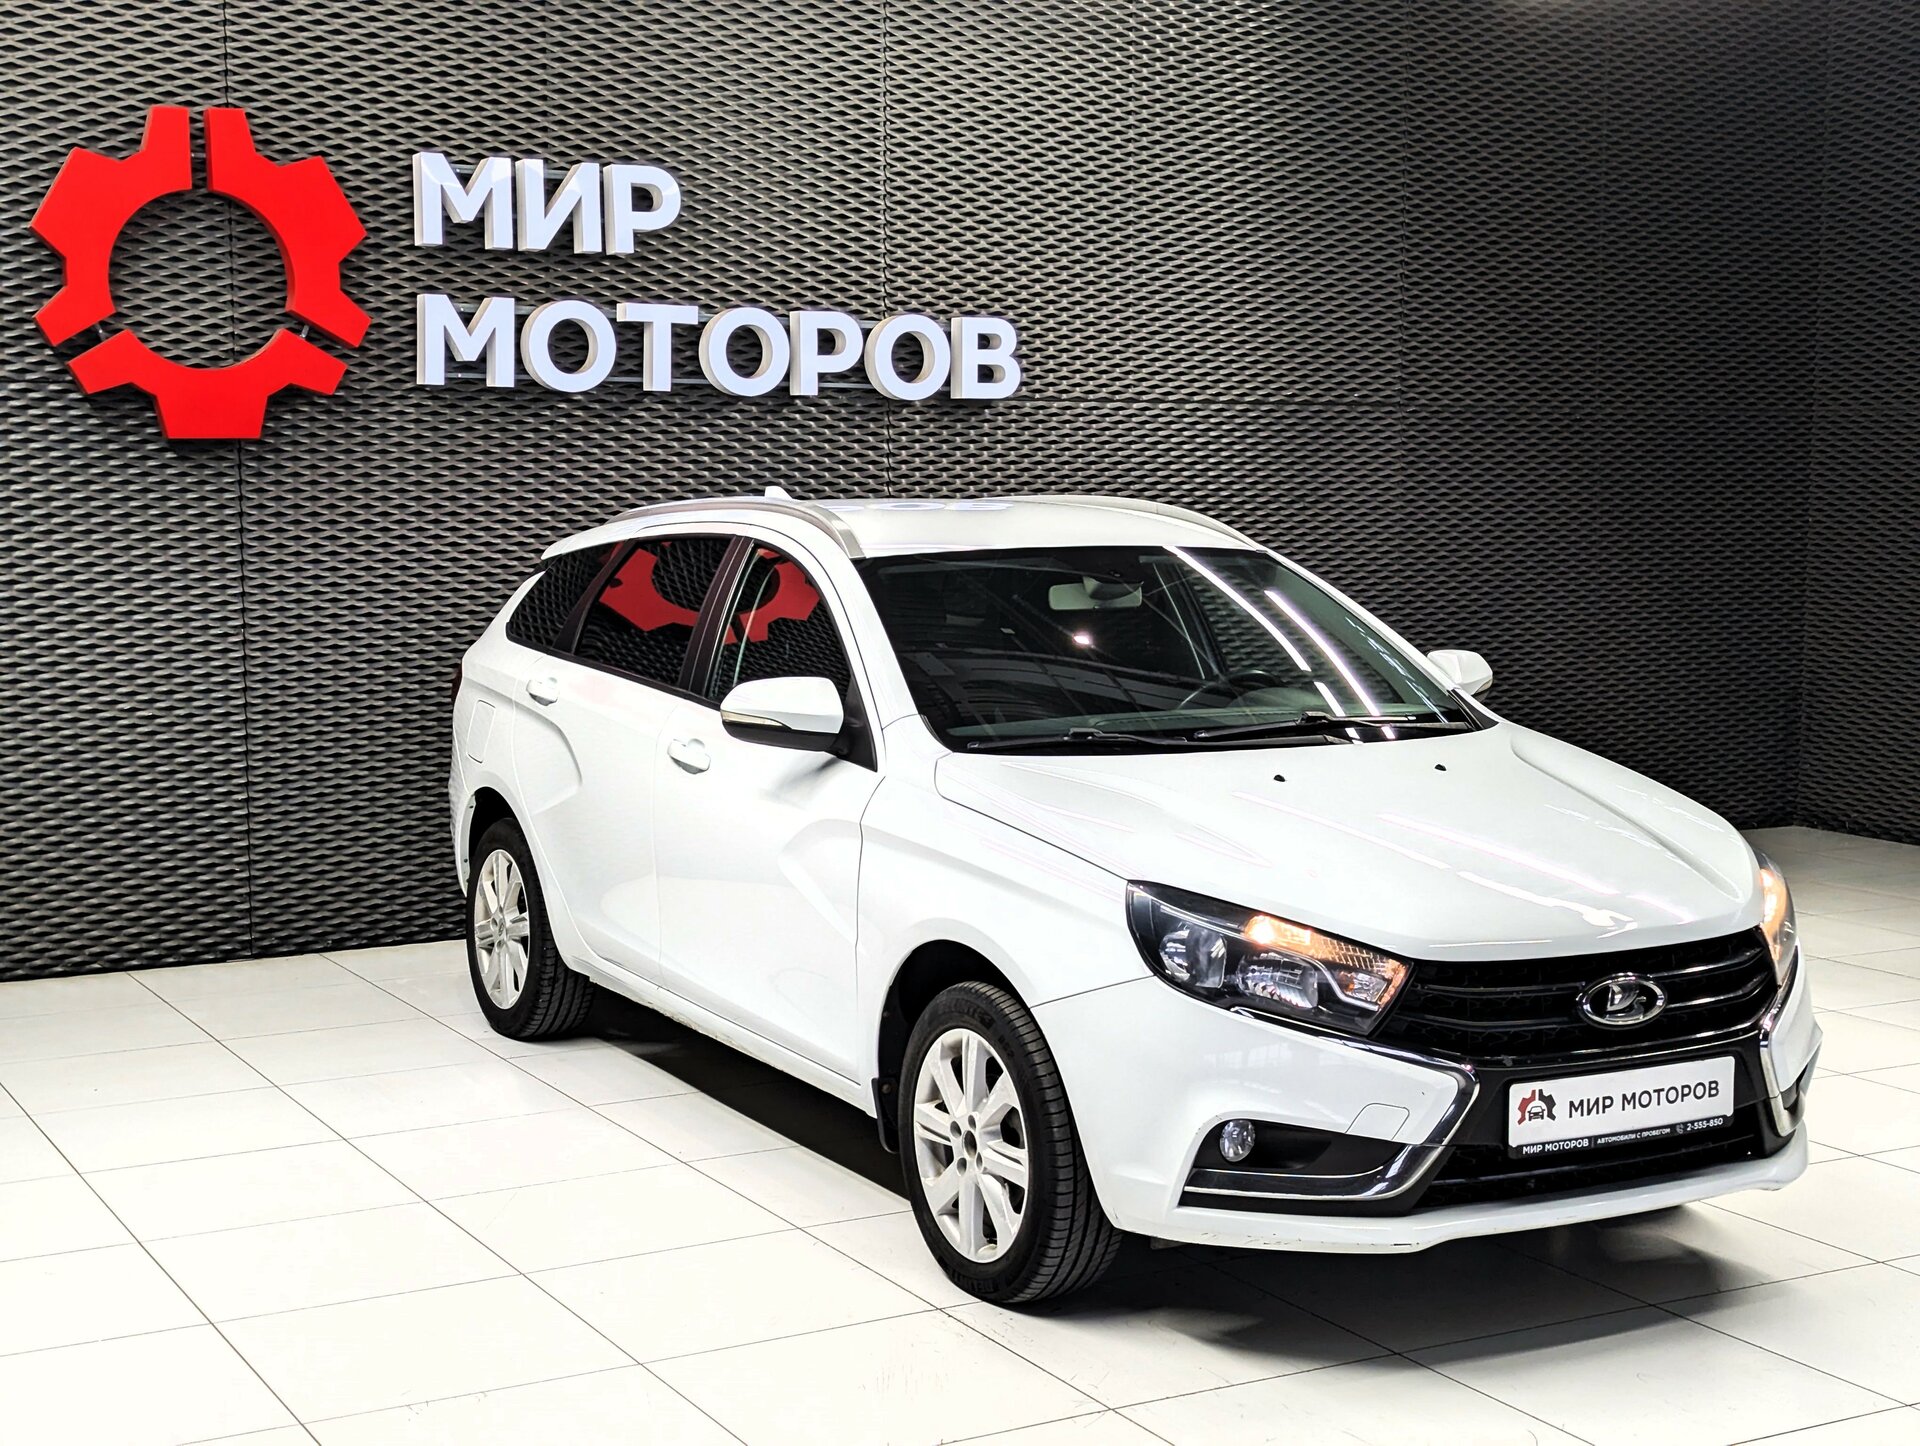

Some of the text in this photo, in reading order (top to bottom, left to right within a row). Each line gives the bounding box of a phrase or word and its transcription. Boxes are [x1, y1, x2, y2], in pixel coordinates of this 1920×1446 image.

[412, 152, 681, 255] МИР
[416, 293, 1022, 401] МОТОРОВ
[1568, 1080, 1720, 1119] МИР МОТОРОВ
[1522, 1145, 1543, 1155] МИР
[1545, 1138, 1589, 1152] МОТОРОВ
[1596, 1132, 1636, 1144] АВТОМОБИЛИ
[1641, 1127, 1671, 1138] ПРОБЕГОМ
[1686, 1117, 1724, 1131] 2-555-850
